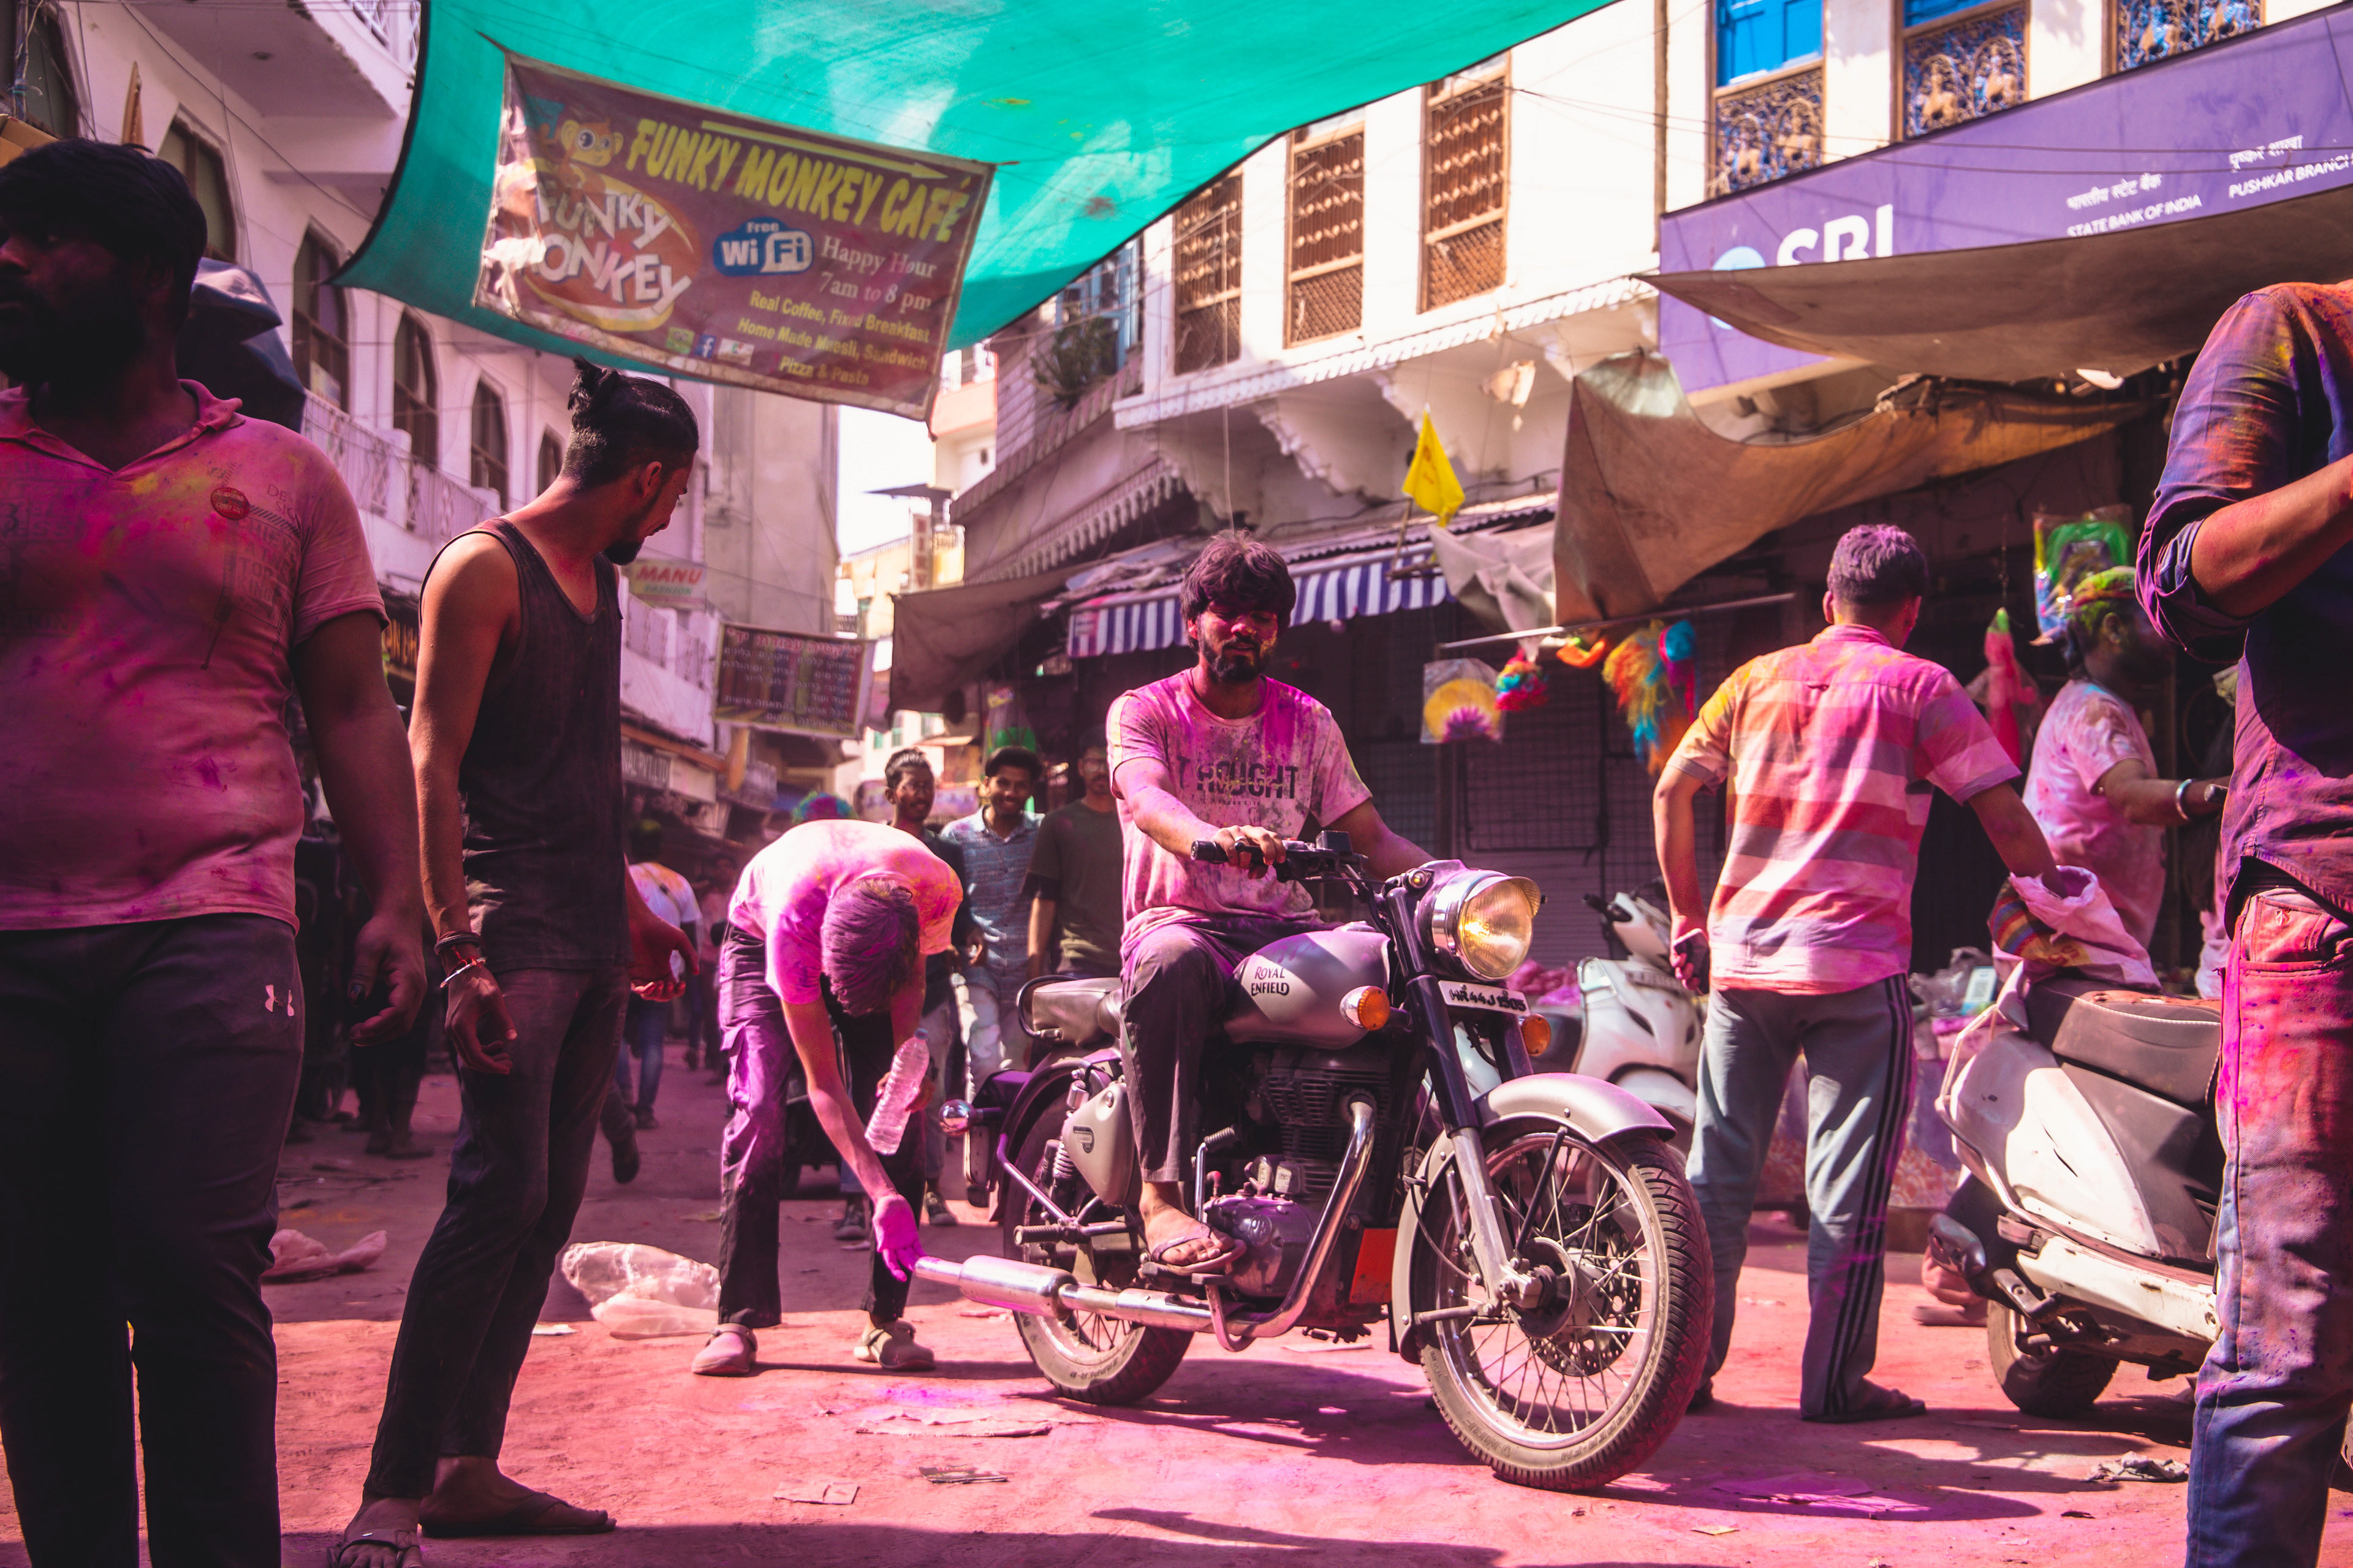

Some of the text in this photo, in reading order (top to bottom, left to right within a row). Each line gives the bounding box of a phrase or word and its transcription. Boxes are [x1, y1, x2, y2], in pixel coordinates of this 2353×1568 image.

[626, 118, 741, 191] FUNKY
[735, 145, 884, 225] MONKEY
[2228, 169, 2295, 199] PUSHKAR
[746, 221, 780, 233] Free
[2066, 193, 2203, 238] STATE BANK OF INDIA
[821, 235, 938, 279] Happy Hour
[818, 271, 933, 314] 7am to 8 pm
[750, 290, 781, 312] Real
[782, 298, 827, 325] Coffee,
[865, 314, 930, 344] Breakfast
[737, 317, 776, 339] Home
[777, 325, 813, 349] Made
[863, 344, 929, 371] Sandwich
[779, 355, 870, 385] Pizza & Pasta
[635, 564, 703, 585] MANU
[1251, 982, 1290, 996] ENFIELD
[1254, 966, 1286, 980] ROYAL
